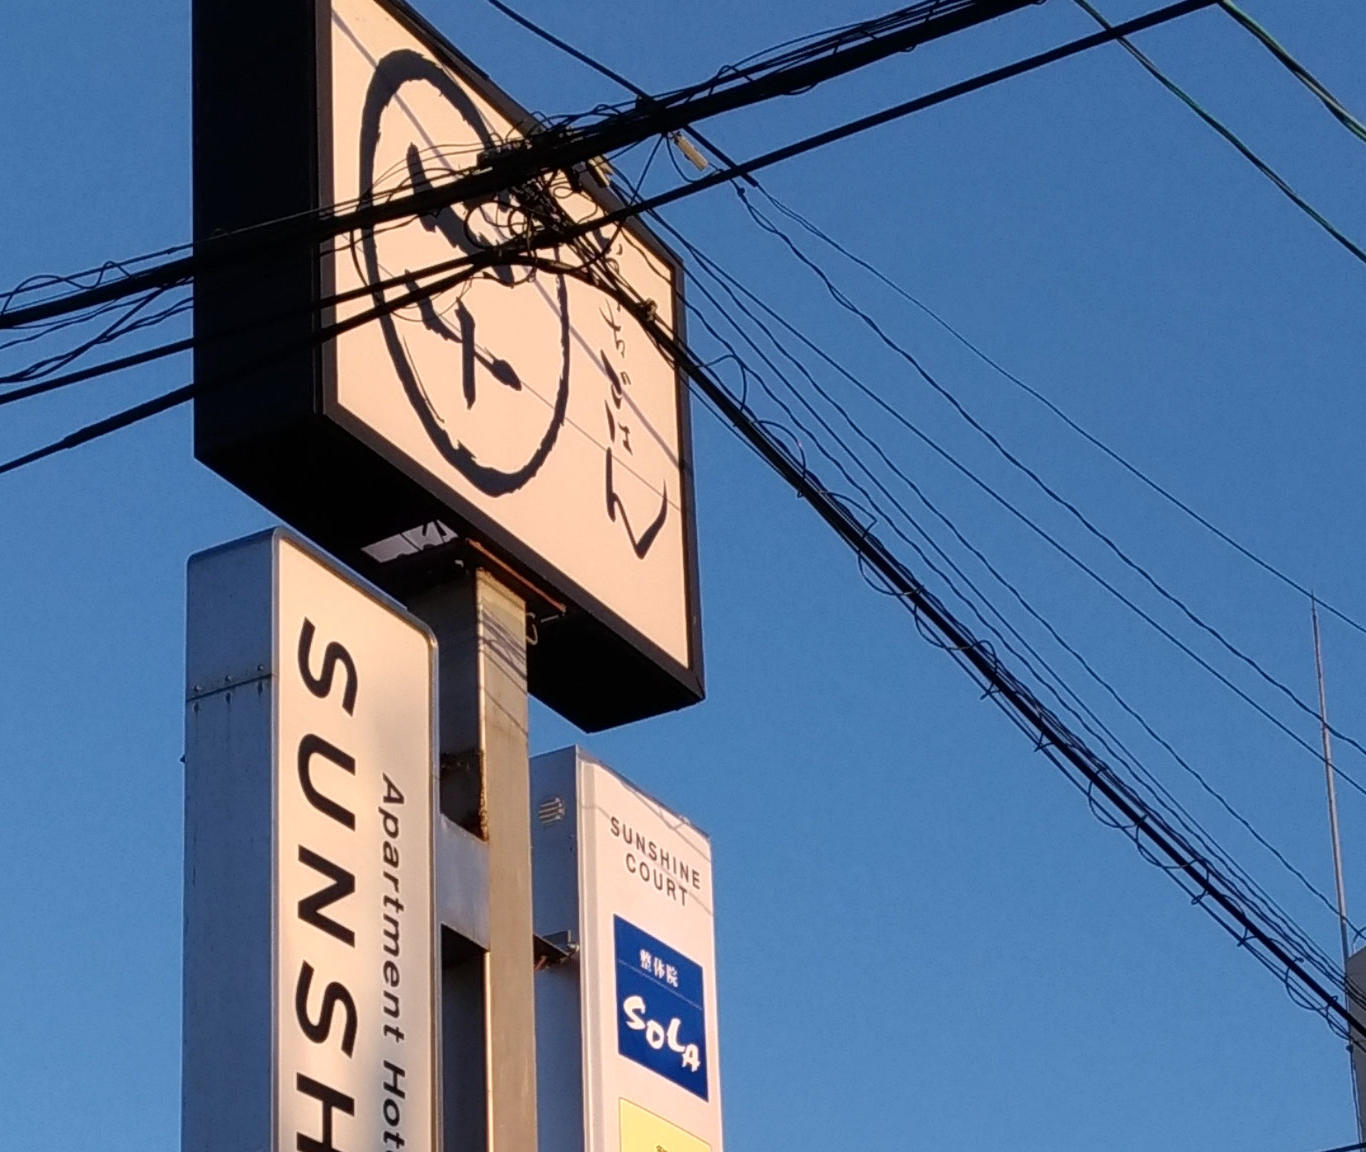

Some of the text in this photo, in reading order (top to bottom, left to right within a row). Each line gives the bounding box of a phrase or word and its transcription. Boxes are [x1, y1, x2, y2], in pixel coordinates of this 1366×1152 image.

[610, 816, 702, 890] SUNSHINE
[626, 852, 689, 907] COURT
[377, 771, 407, 1042] Apartment
